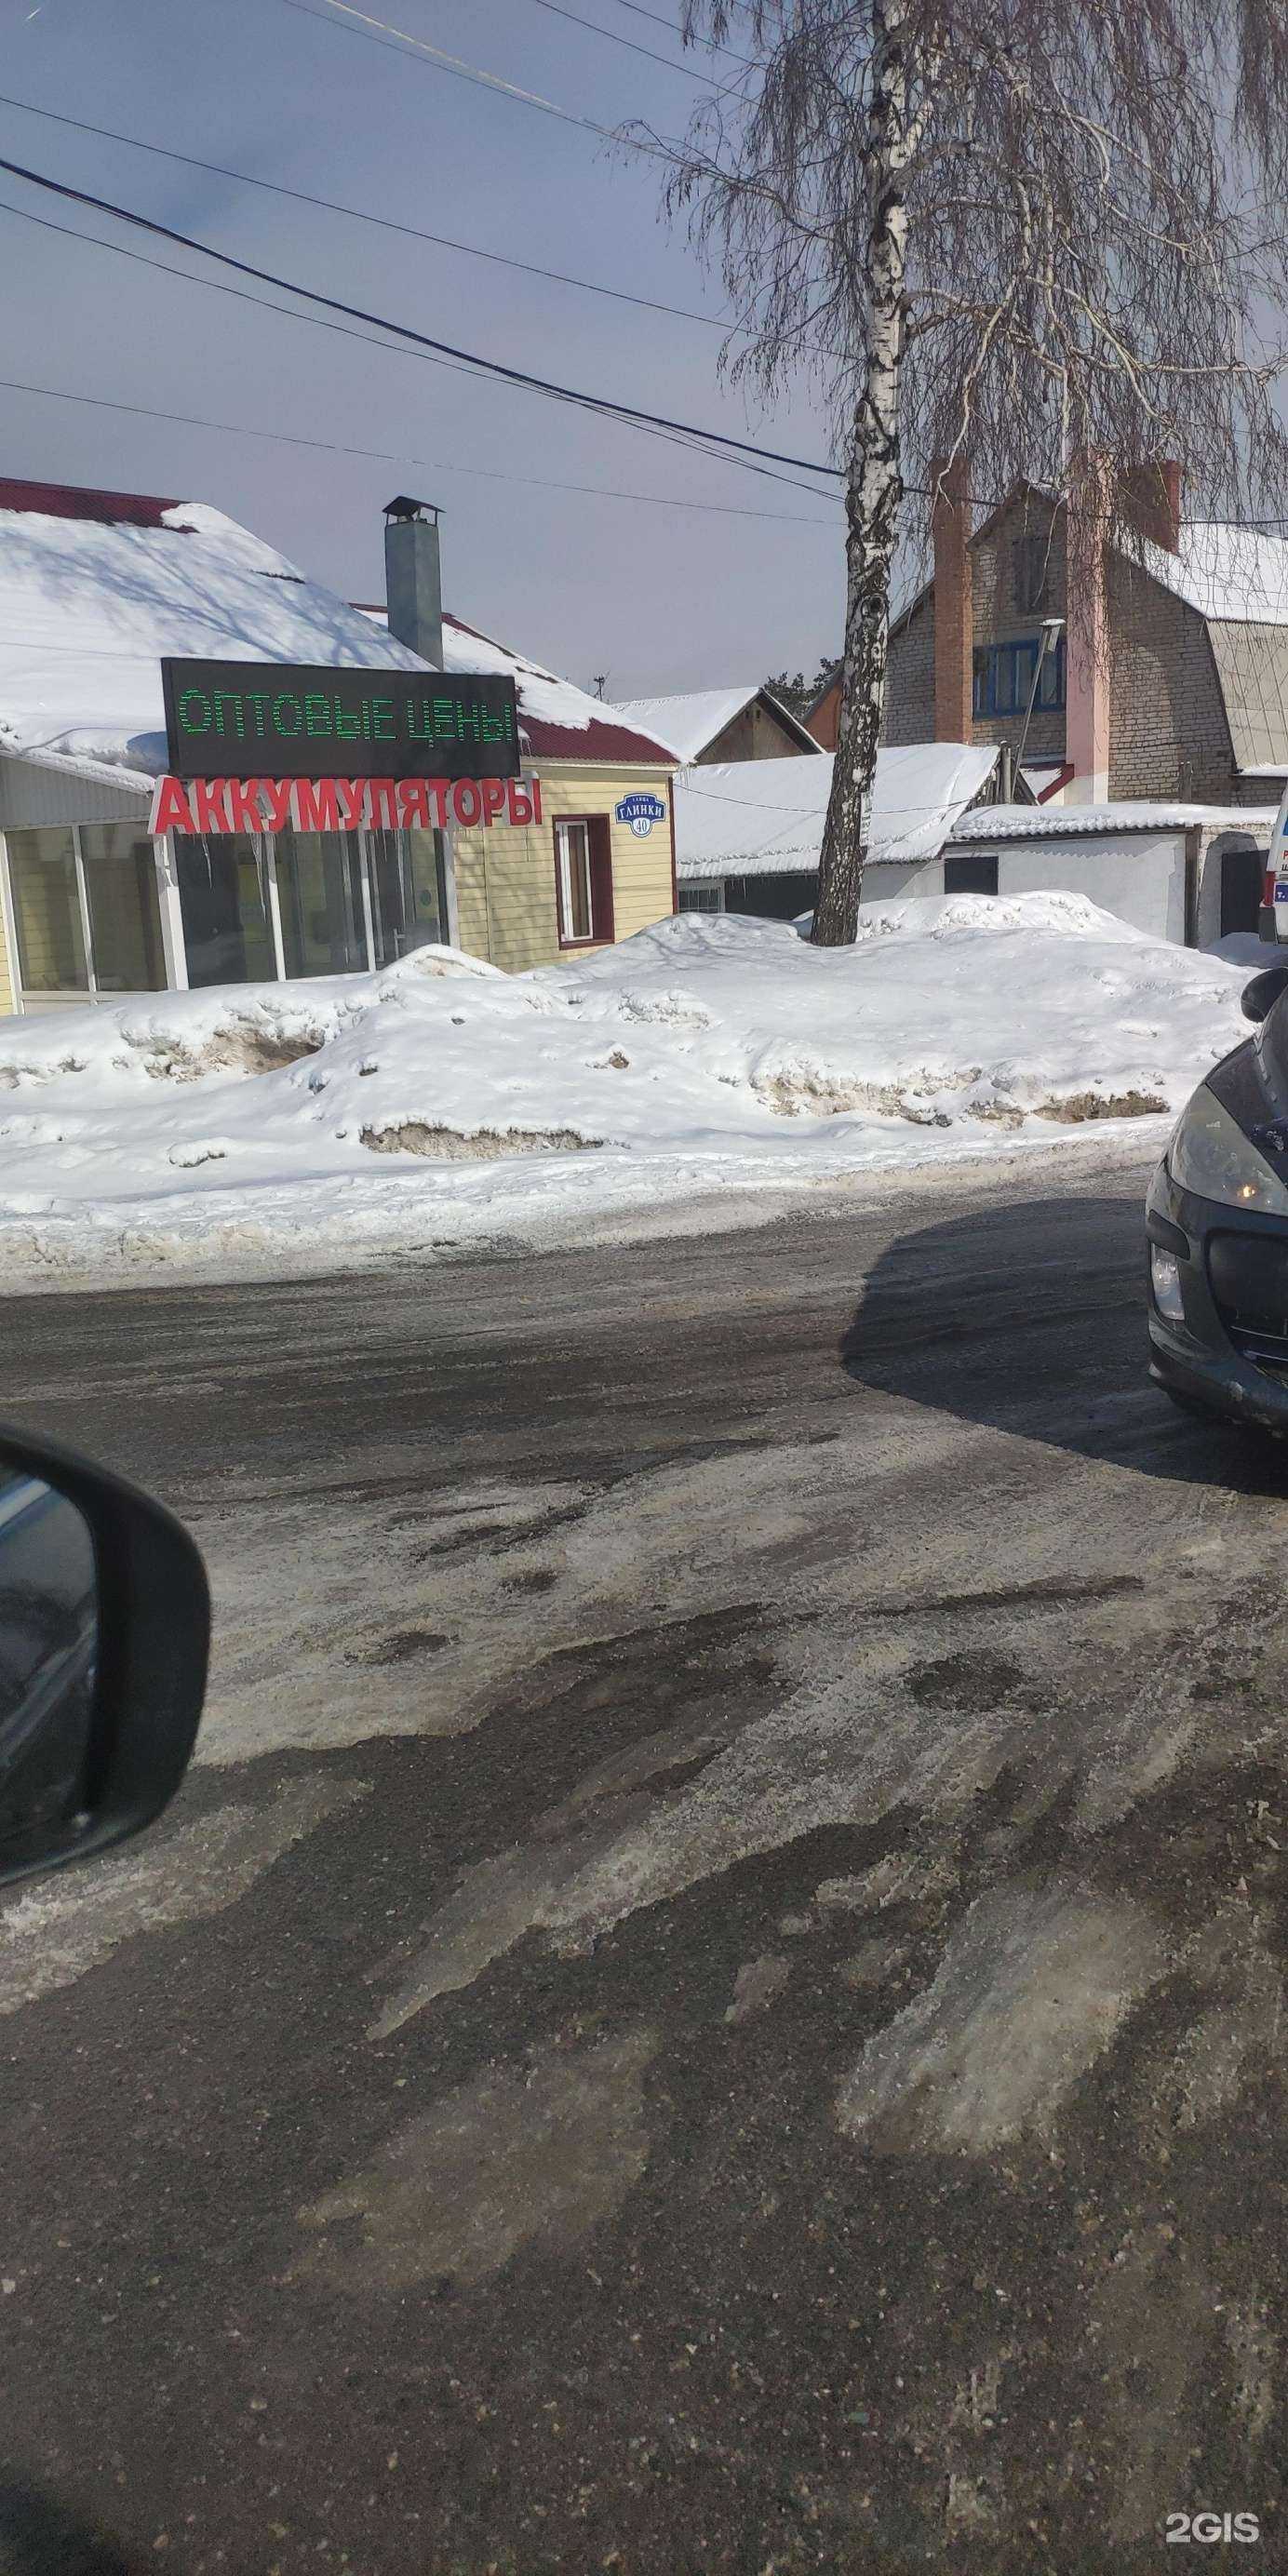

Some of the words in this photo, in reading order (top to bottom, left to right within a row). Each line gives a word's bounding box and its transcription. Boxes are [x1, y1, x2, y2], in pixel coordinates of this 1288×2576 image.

[179, 687, 397, 741] ОПТОВЫЕ
[407, 699, 513, 748] ЦЕНЫ
[154, 776, 543, 834] АККУМУЛЯТОРЫ
[619, 804, 662, 819] ГЛИНКИ
[637, 819, 648, 833] 40
